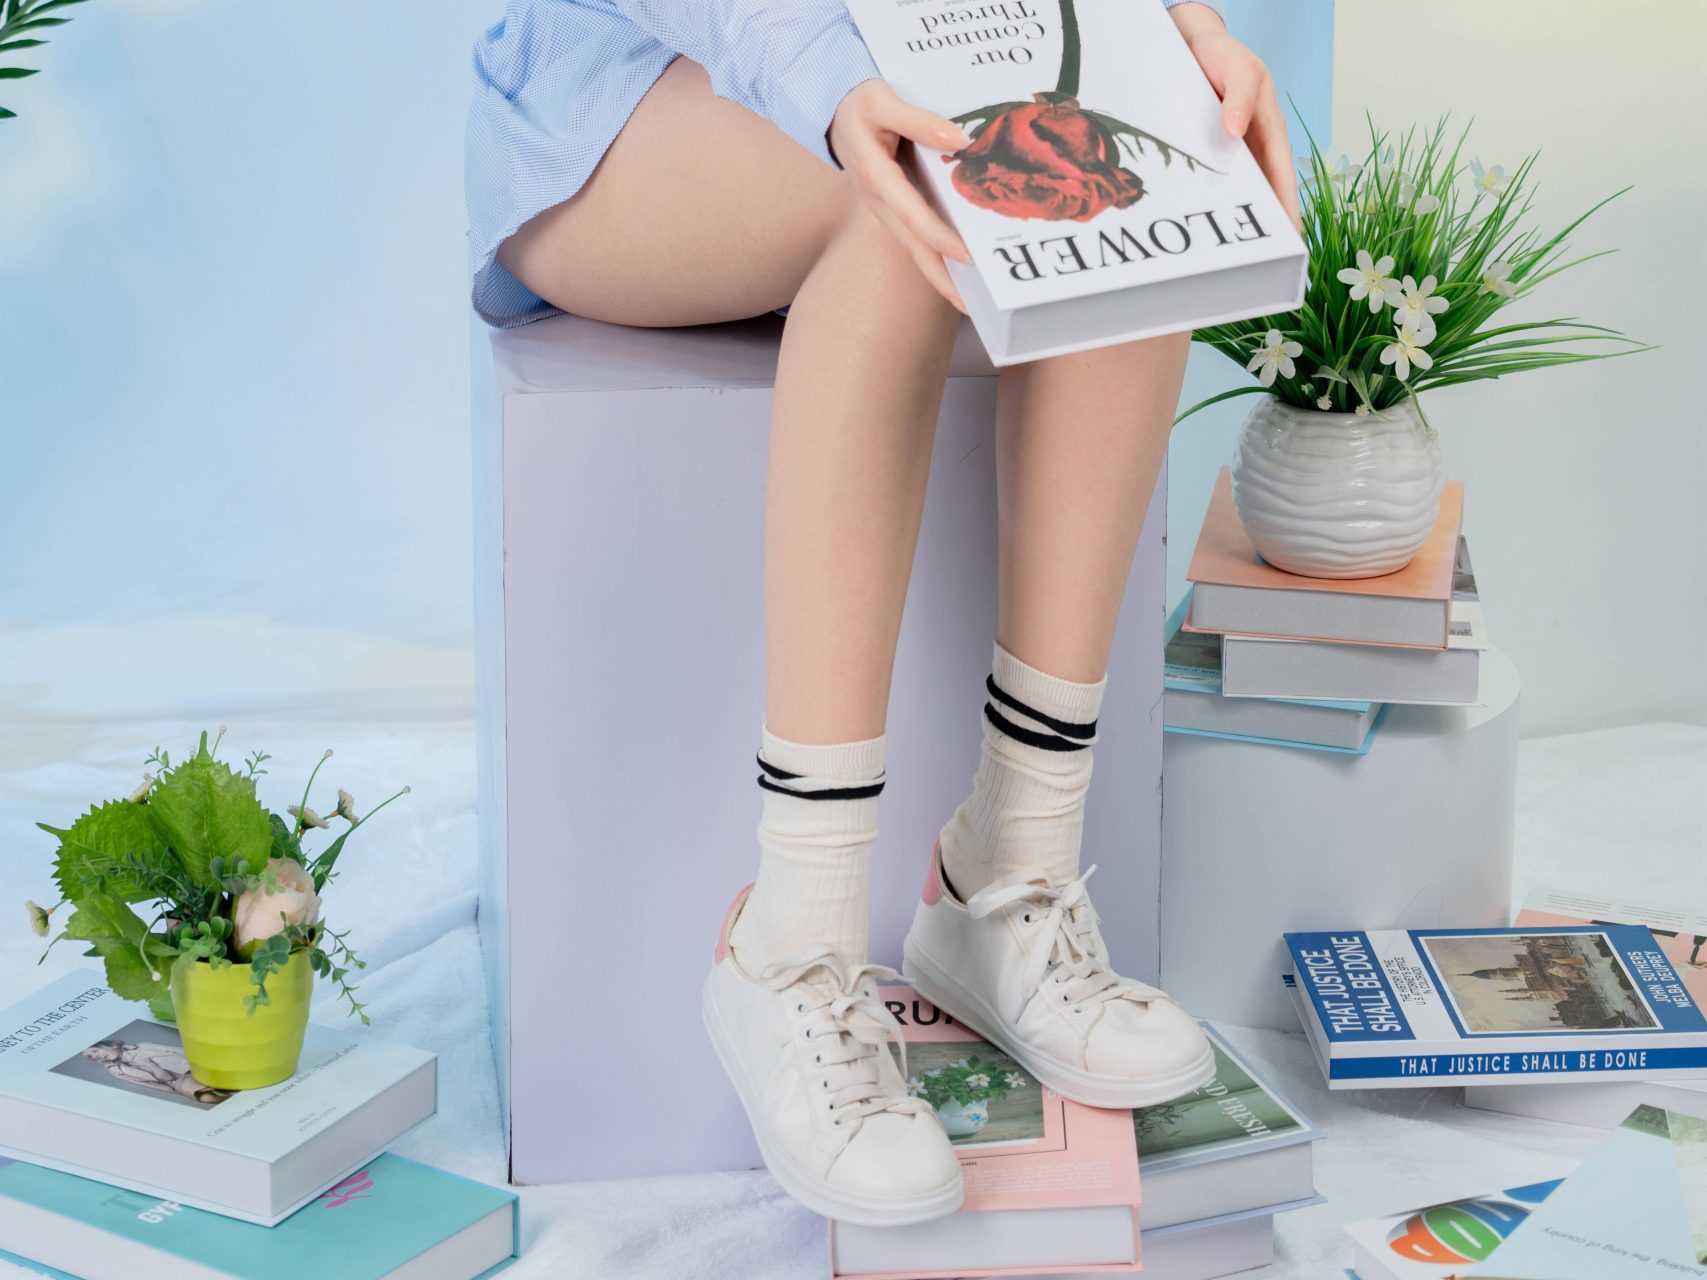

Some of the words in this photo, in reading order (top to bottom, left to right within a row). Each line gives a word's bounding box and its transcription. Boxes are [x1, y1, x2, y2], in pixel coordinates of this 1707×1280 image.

[919, 0, 1037, 33] Thread
[906, 21, 1045, 53] Common
[971, 46, 1033, 65] Our
[993, 203, 1271, 283] FLOWER
[1330, 936, 1374, 970] DONE
[1627, 951, 1657, 981] SUTHERS
[1644, 951, 1676, 981] DEUPREY
[1301, 949, 1350, 999] JUSTICE
[1347, 972, 1382, 989] BE
[1647, 984, 1671, 1003] JOHN
[1665, 984, 1692, 1008] MELBA
[16, 1025, 42, 1037] TO
[33, 1011, 67, 1026] THE
[58, 987, 111, 1013] CENTER
[885, 1000, 954, 1026] RU
[1323, 1001, 1364, 1033] THAT
[1357, 991, 1402, 1032] SHALL
[1400, 1058, 1437, 1074] THAT
[1449, 1055, 1511, 1073] JUSTICE
[1522, 1053, 1568, 1070] SHALL
[1579, 1053, 1597, 1069] BE
[1604, 1051, 1647, 1068] DONE
[1217, 1097, 1272, 1137] FRESH
[1602, 1244, 1629, 1256] king
[1630, 1252, 1652, 1262] the
